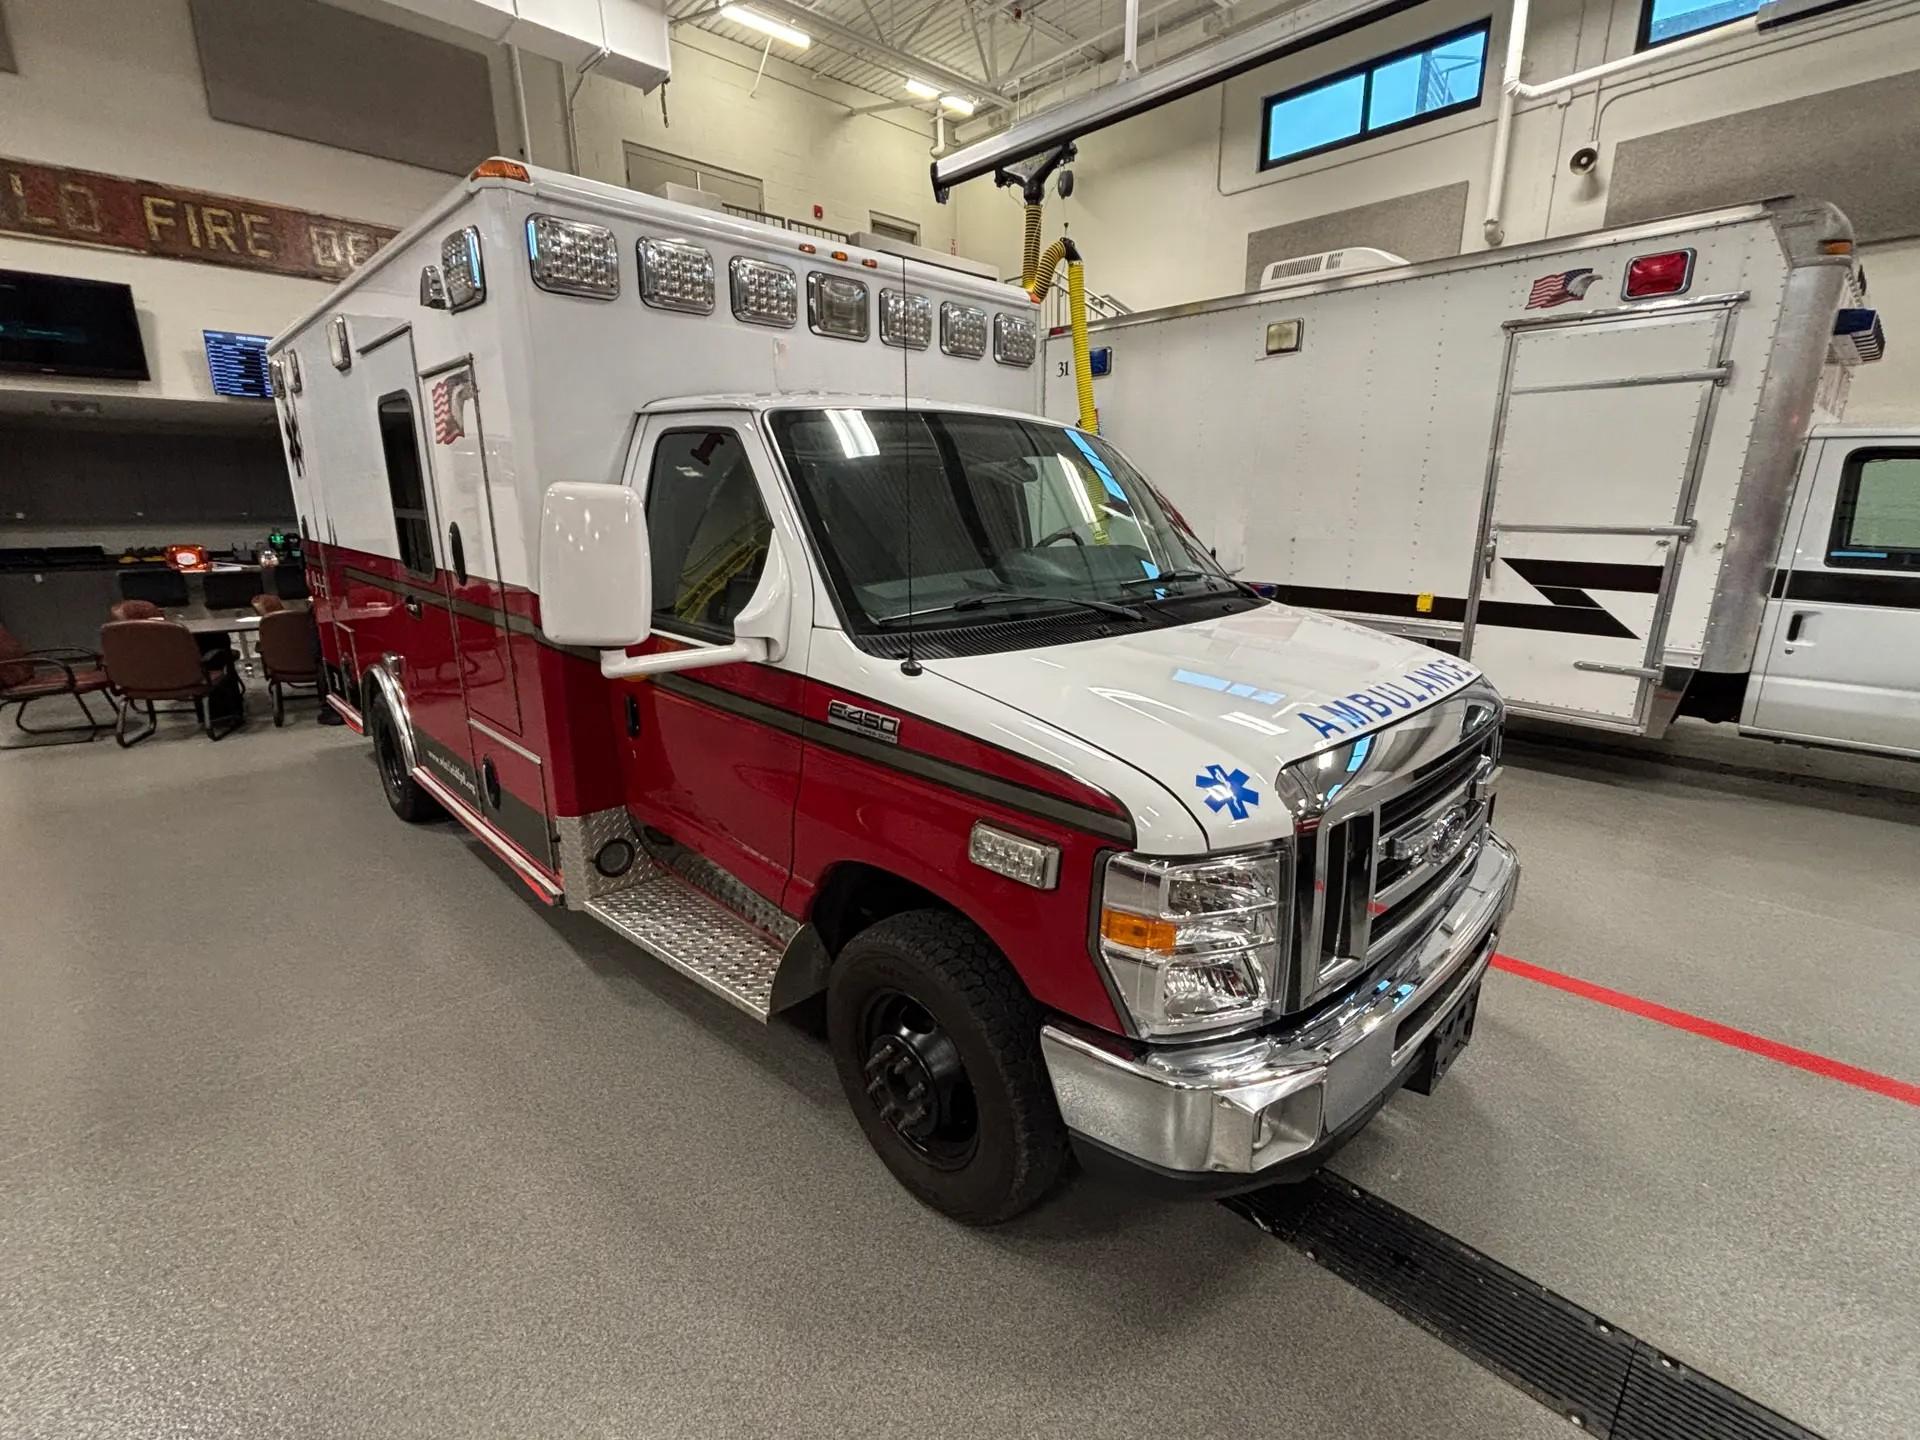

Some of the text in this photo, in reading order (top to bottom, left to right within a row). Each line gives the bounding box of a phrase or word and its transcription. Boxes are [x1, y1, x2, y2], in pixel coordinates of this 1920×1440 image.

[142, 196, 273, 258] FIRE
[309, 225, 392, 269] DE
[1056, 361, 1070, 378] 31
[1297, 659, 1473, 739] AMBULANCE
